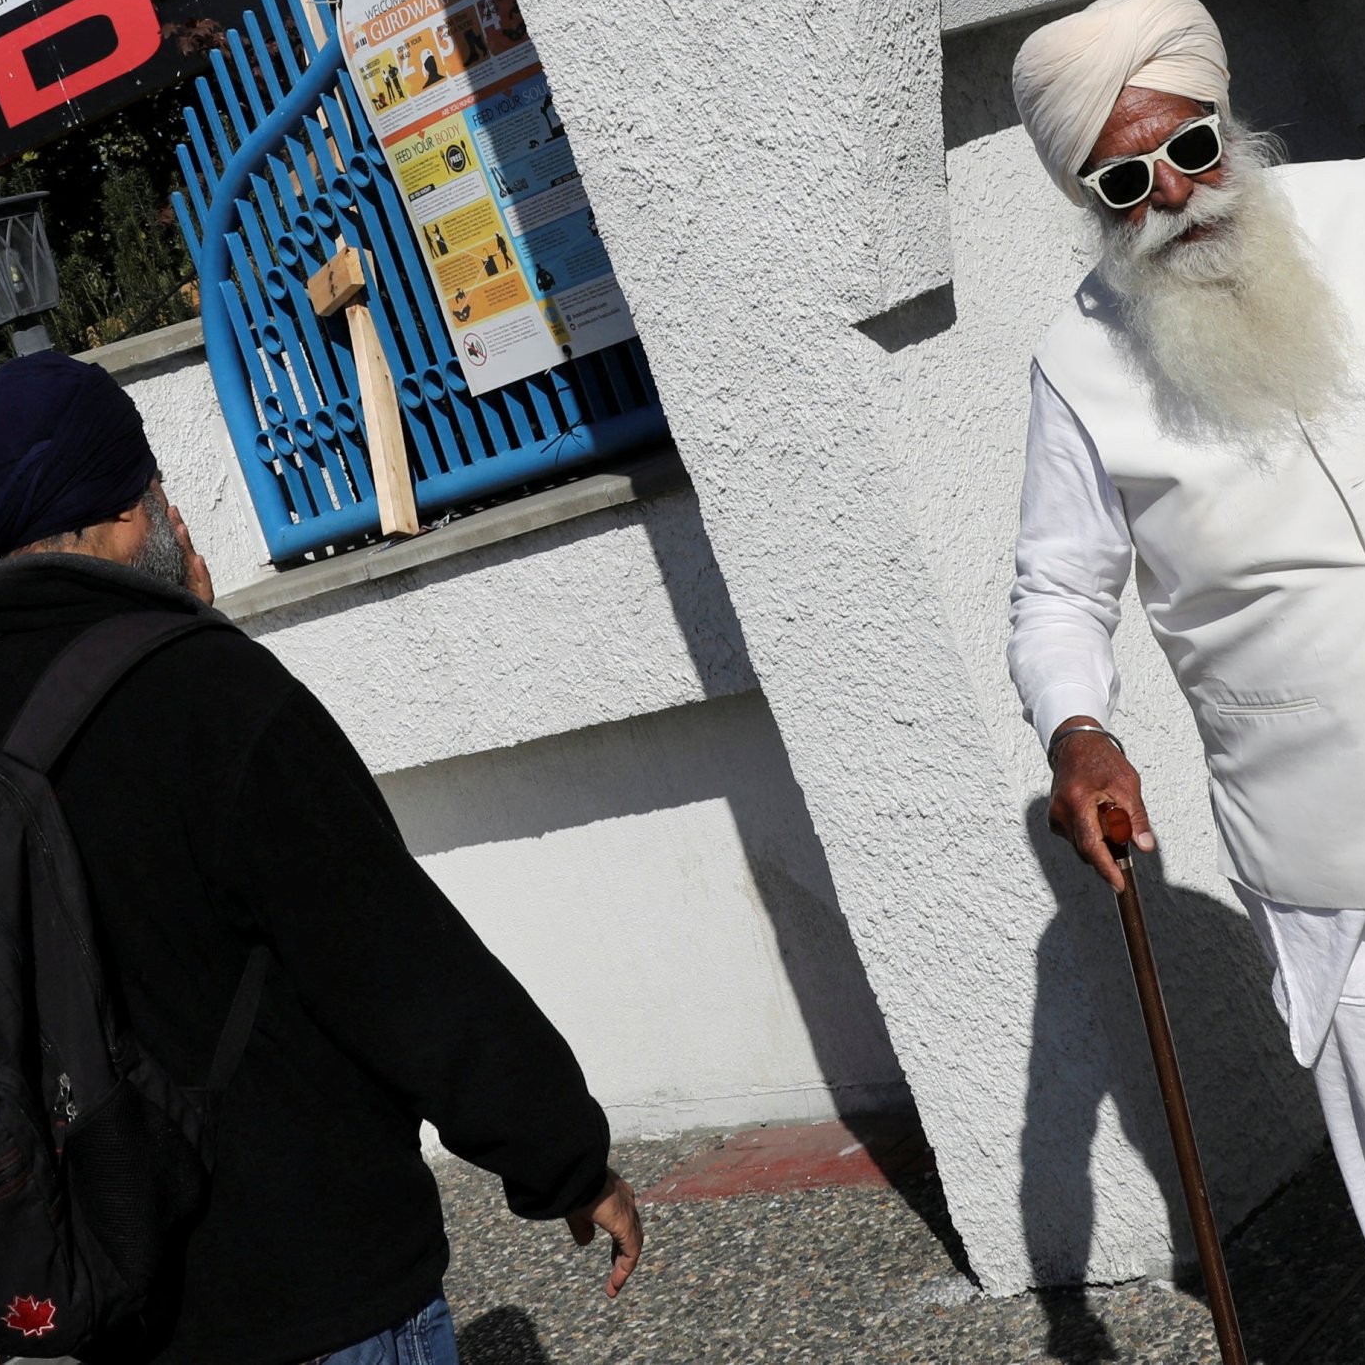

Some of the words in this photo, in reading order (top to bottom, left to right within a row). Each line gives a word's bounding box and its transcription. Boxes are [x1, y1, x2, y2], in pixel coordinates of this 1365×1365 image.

[472, 108, 494, 127] FEED
[494, 95, 520, 115] YOUR
[521, 84, 548, 103] SOU
[395, 149, 412, 166] FEED
[411, 137, 434, 155] YOUR
[435, 124, 461, 145] BODY
[449, 152, 463, 163] FREE
